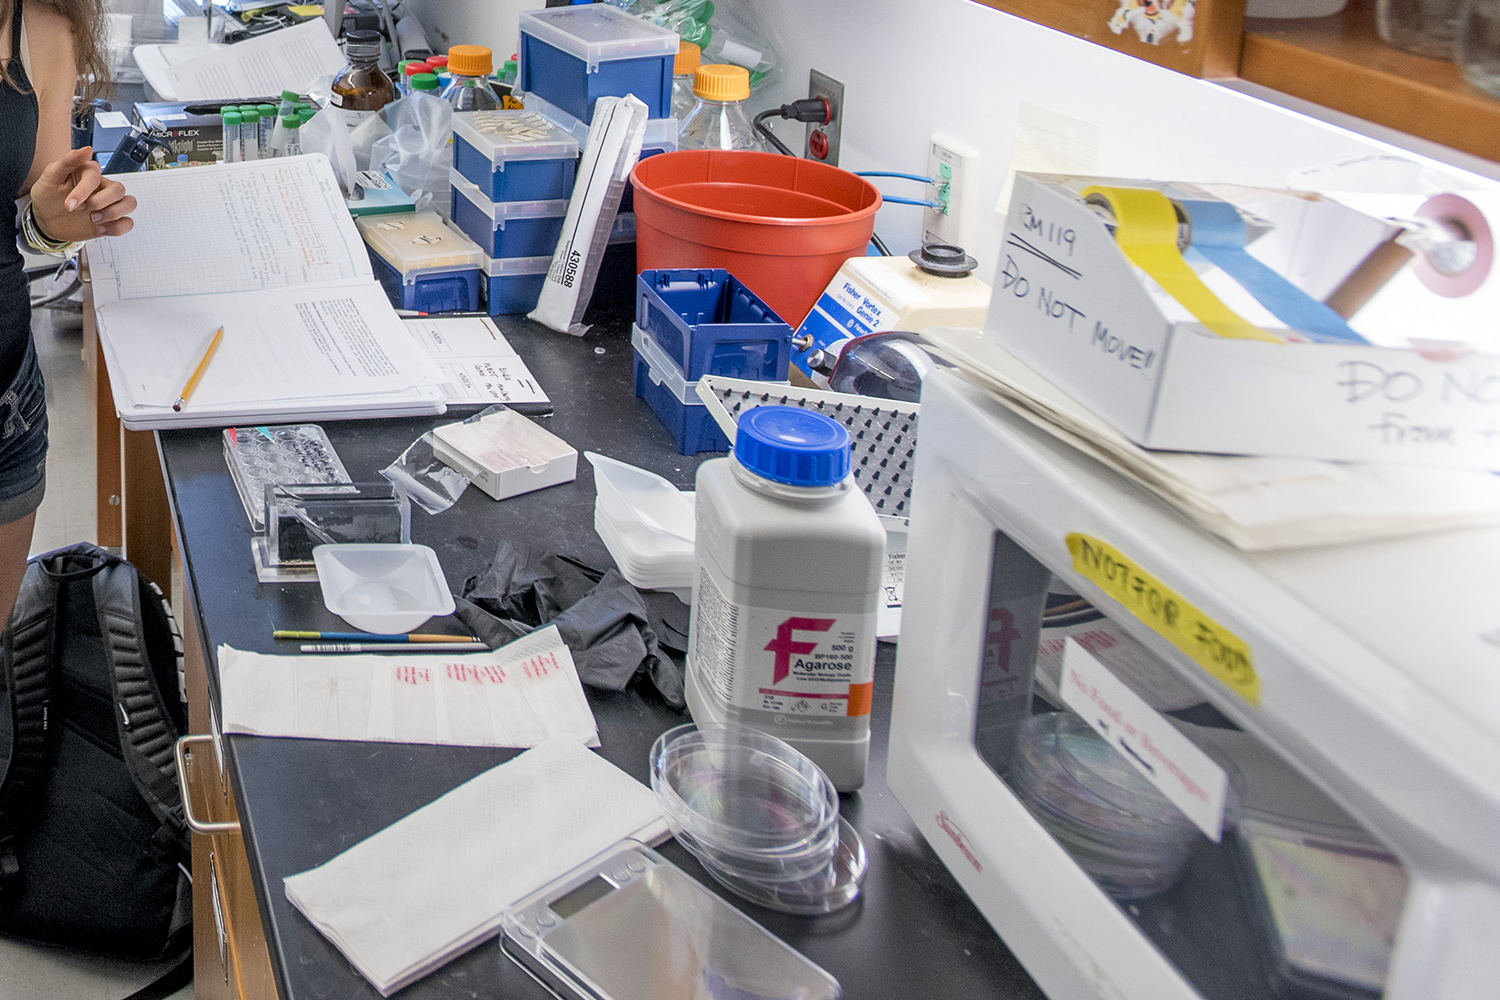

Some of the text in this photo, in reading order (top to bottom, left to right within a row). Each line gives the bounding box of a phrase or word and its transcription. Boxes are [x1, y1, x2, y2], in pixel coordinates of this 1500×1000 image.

[152, 129, 200, 138] MICROFLEX
[563, 249, 582, 289] 430588
[842, 282, 861, 300] Fisher
[862, 297, 882, 317] Vortex
[1002, 254, 1030, 298] DO
[1038, 286, 1087, 334] NOT
[856, 306, 880, 328] Genie 2
[1336, 360, 1500, 405] DO NO
[1080, 537, 1130, 592] NOT
[794, 658, 852, 673] Agarose
[814, 653, 854, 661] BP160-500
[831, 644, 854, 653] 500 g
[1089, 686, 1123, 726] Food
[1139, 731, 1212, 804] Beverages
